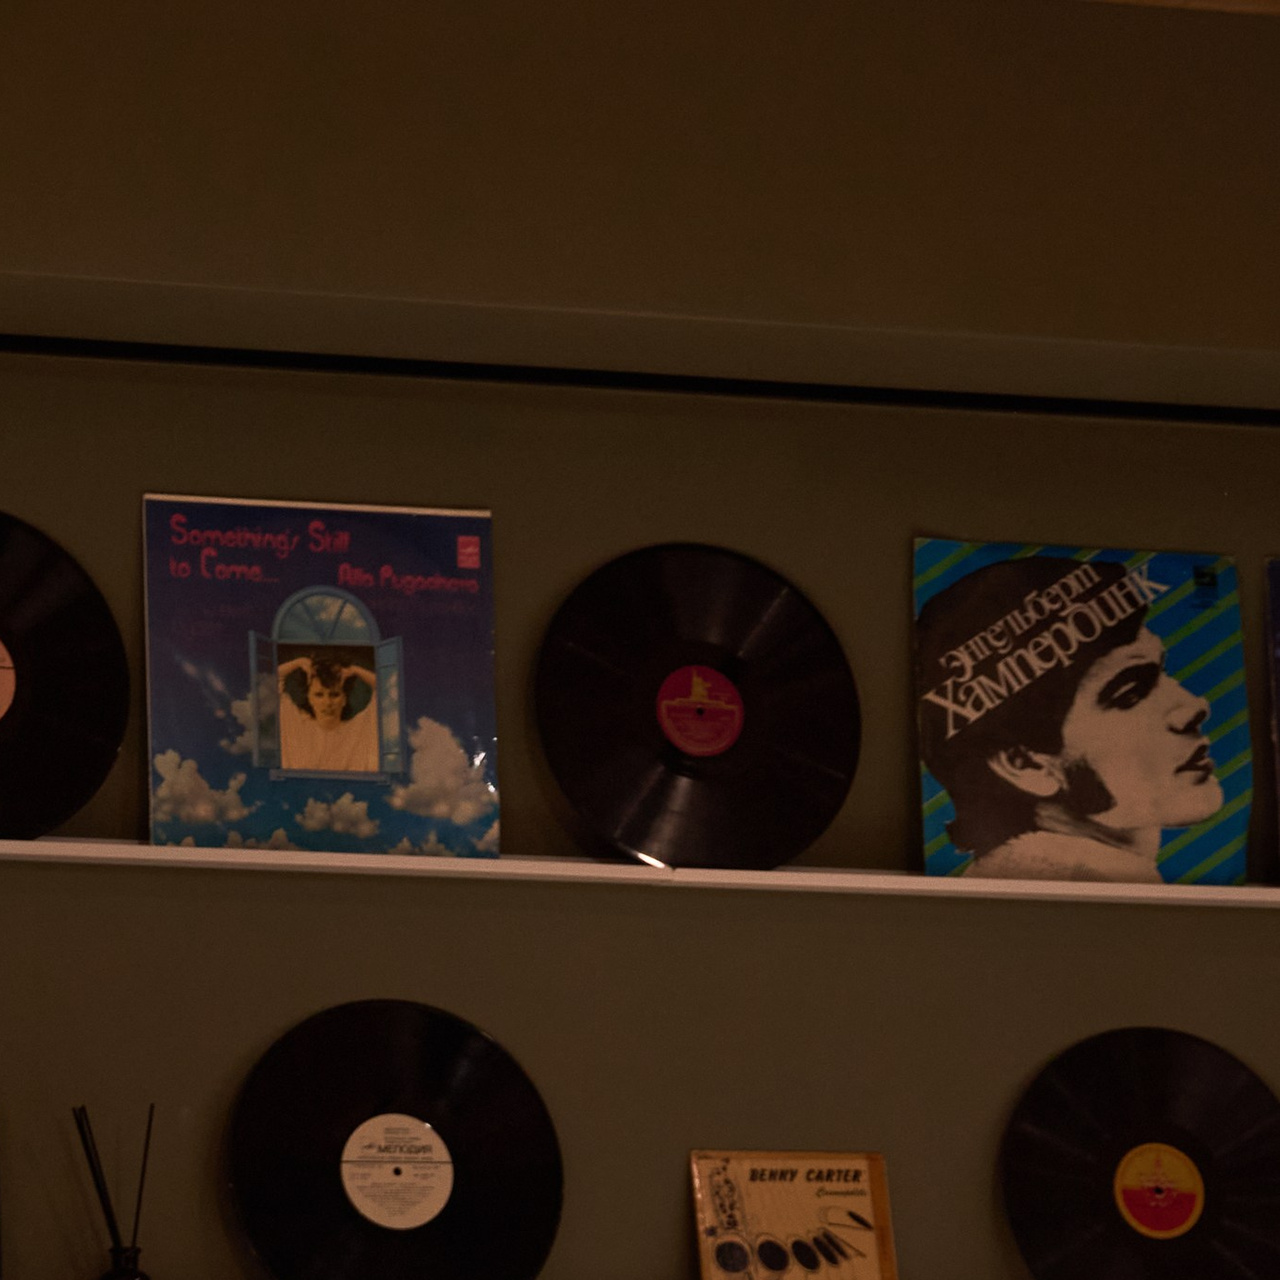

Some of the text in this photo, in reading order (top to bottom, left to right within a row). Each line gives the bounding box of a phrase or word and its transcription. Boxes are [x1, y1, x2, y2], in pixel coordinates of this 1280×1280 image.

[169, 557, 191, 579] to
[749, 1168, 862, 1183] BENNY CARTER
